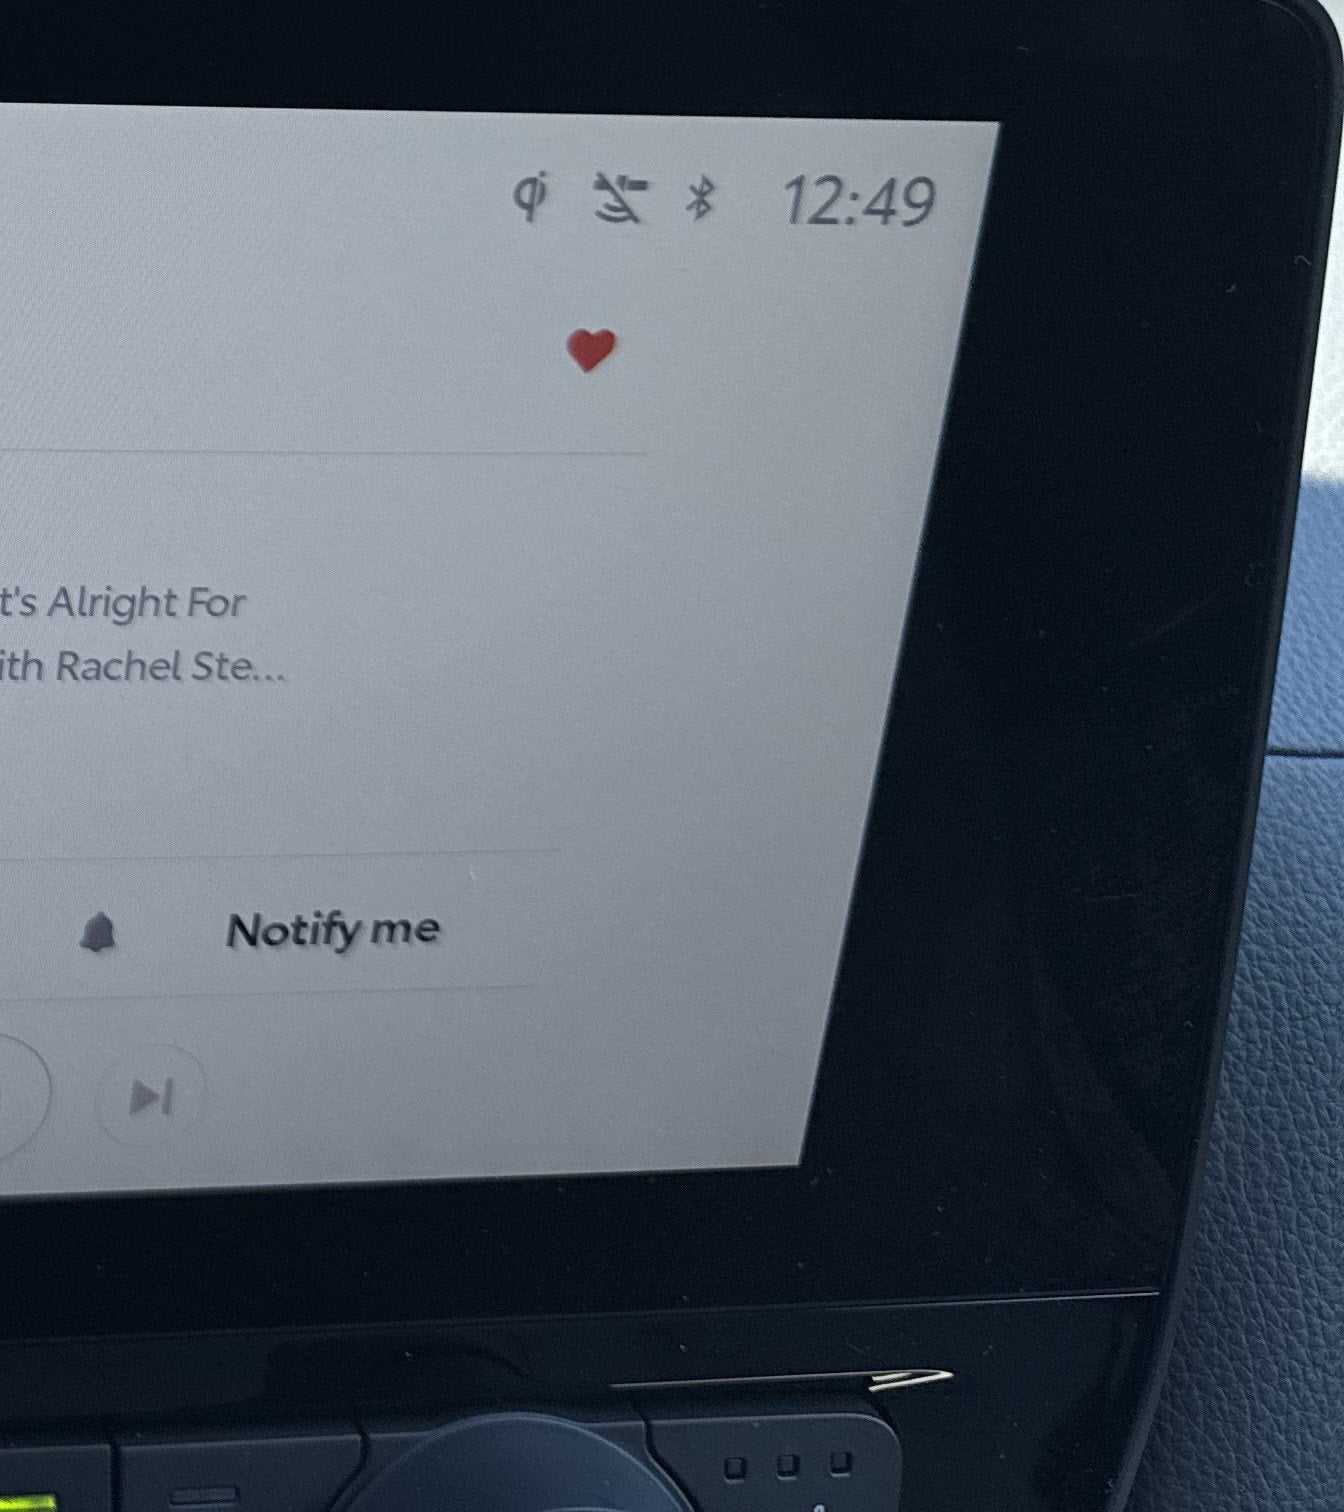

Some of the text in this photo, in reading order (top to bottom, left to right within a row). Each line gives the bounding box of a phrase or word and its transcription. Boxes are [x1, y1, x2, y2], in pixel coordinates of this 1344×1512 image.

[784, 174, 937, 228] 12:49
[46, 585, 178, 627] Alright
[187, 586, 247, 618] For
[56, 649, 182, 682] Rachel
[191, 650, 287, 683] Ste...
[226, 909, 443, 956] Notify me
